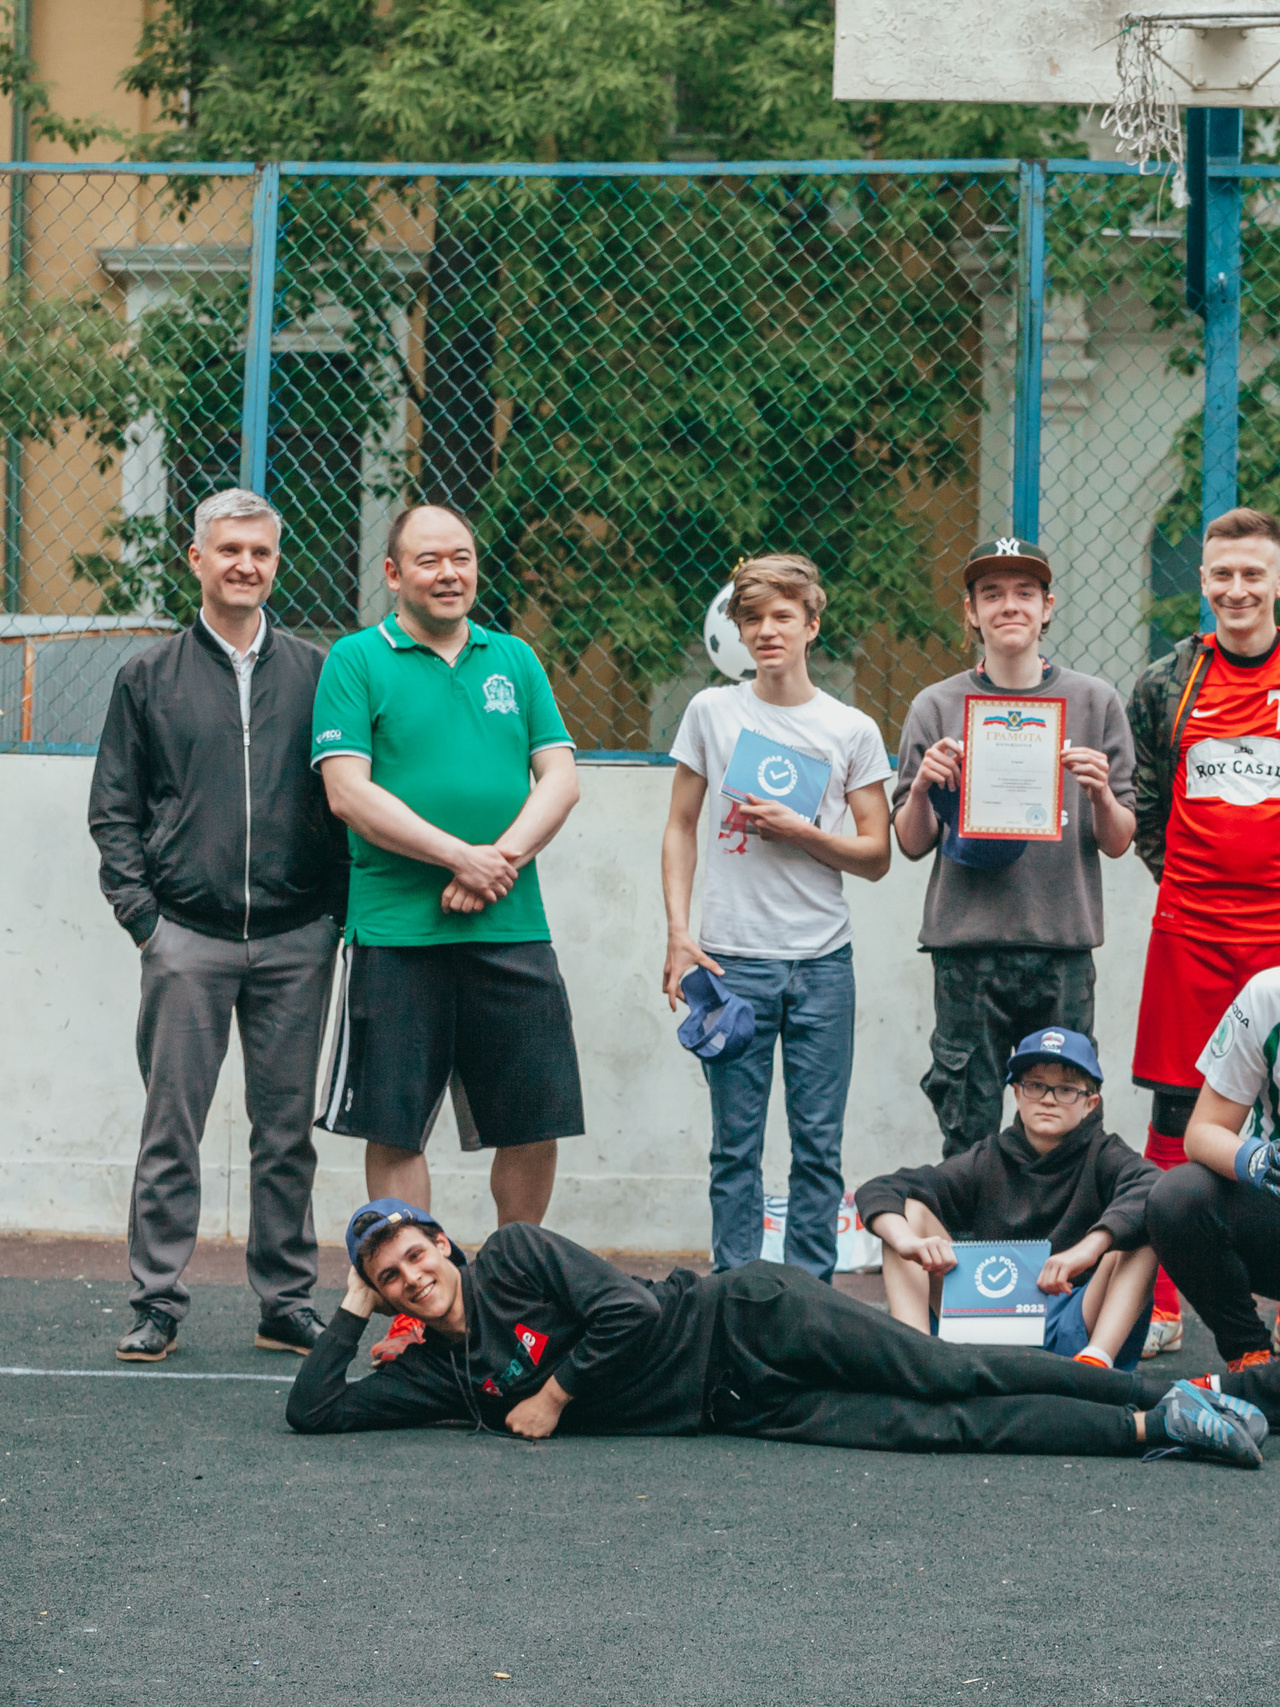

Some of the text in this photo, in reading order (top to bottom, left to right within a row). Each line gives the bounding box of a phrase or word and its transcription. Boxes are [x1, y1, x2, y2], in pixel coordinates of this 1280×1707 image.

[995, 537, 1021, 556] NY
[986, 731, 1043, 743] ГРАМОТА
[1196, 763, 1227, 780] ROY
